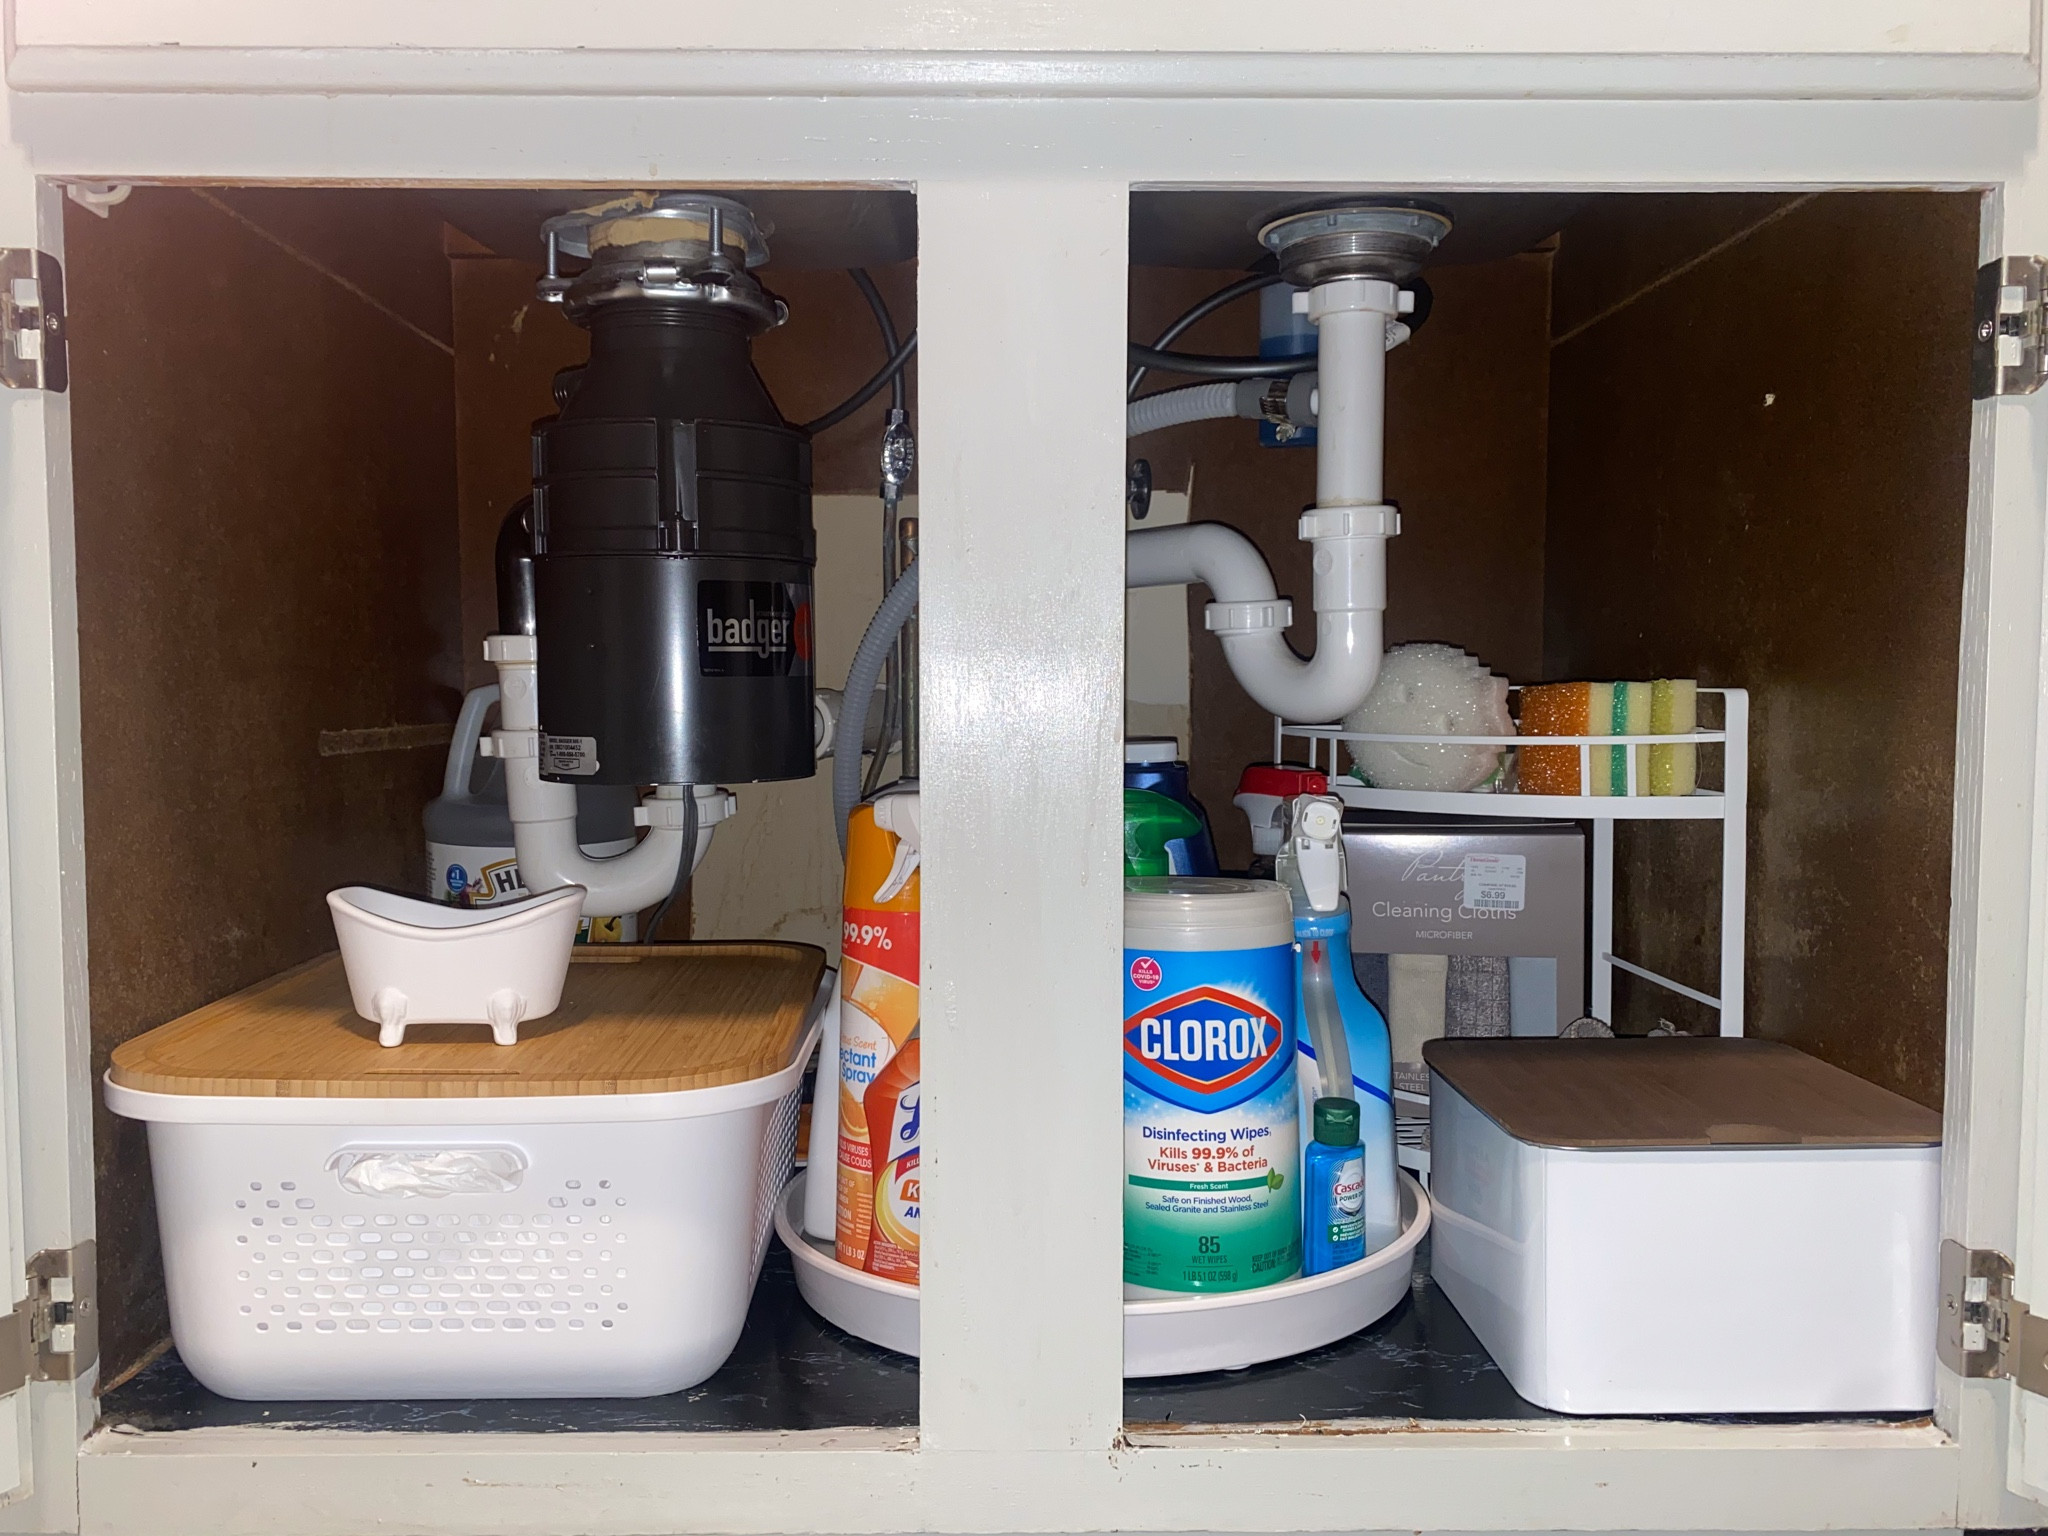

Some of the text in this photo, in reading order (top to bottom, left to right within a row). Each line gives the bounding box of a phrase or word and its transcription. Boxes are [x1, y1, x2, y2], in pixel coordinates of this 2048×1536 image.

[707, 598, 790, 659] badger
[1480, 890, 1506, 900] $6.99
[1372, 902, 1452, 923] Cleaning
[843, 920, 893, 951] 99.9%
[1415, 931, 1474, 941] MICROFIBER
[1140, 1015, 1268, 1062] CLOROX
[1399, 1083, 1426, 1092] STEEL
[1142, 1126, 1226, 1143] Disinfecting
[1159, 1144, 1255, 1160] Kills 99.9% of
[851, 1155, 872, 1169] COLDS
[1203, 1162, 1213, 1173] &
[1217, 1157, 1268, 1173] Bacteria
[1145, 1200, 1270, 1214] Sealed Granite and Stainless Steel
[1162, 1195, 1179, 1204] Safe
[1193, 1195, 1227, 1205] Finished
[1228, 1194, 1253, 1204] Wood,
[1198, 1236, 1221, 1254] 85
[1191, 1255, 1228, 1264] WET WIPES
